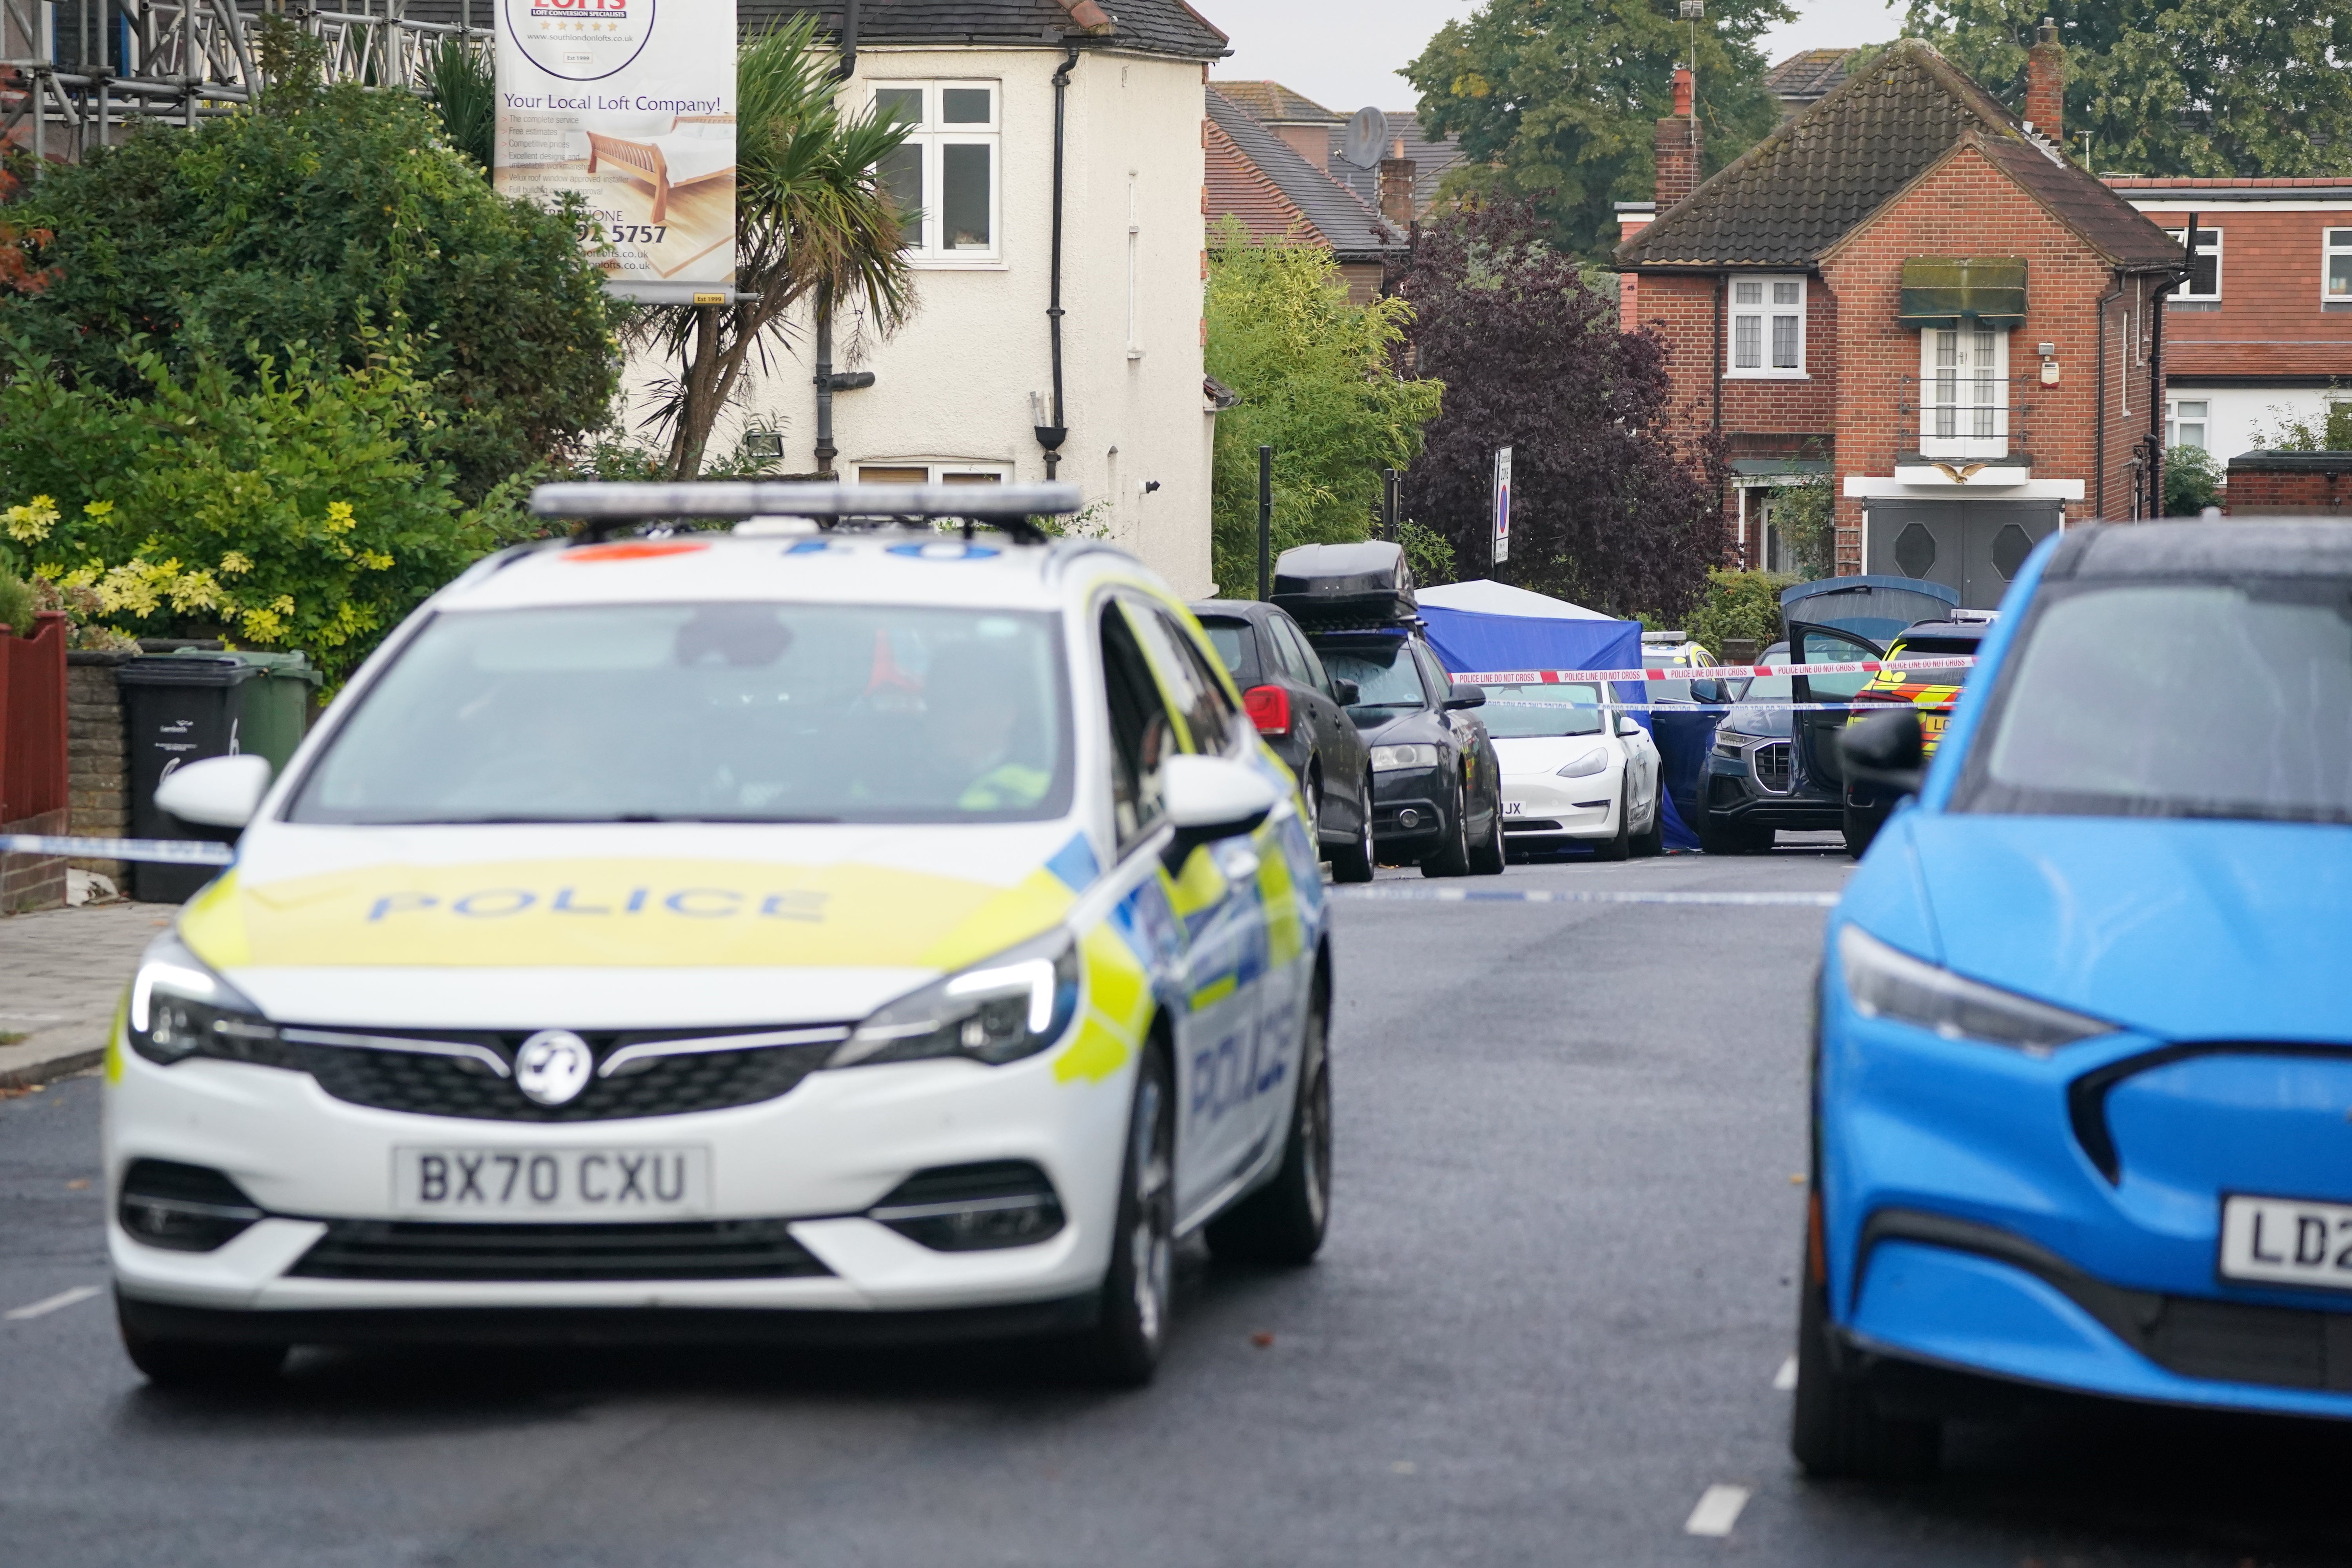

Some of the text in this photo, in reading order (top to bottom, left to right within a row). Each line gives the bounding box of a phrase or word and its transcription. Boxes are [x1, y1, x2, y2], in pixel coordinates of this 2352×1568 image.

[527, 34, 633, 42] www.southlondonlofts.co.uk
[504, 93, 720, 115] Your Local Loft Company!
[509, 114, 521, 123] The
[523, 116, 554, 124] complete
[509, 139, 570, 149] Competitive prices
[539, 152, 565, 162] designs
[570, 176, 600, 184] approved
[612, 225, 666, 243] 5757
[1671, 670, 1690, 678] POLICE
[1692, 669, 1704, 677] LINE
[1728, 668, 1747, 676] CROSS
[1778, 666, 1798, 674] POLICE
[1837, 664, 1855, 672] CROSS
[1460, 675, 1479, 683] POLICE
[1481, 674, 1492, 682] LINE
[1516, 673, 1534, 682] CROSS
[1565, 673, 1584, 681] POLICE
[1586, 672, 1598, 681] LINE
[1609, 671, 1620, 680] NOT
[1622, 671, 1640, 679] CROSS
[367, 887, 829, 924] POLICE
[421, 1154, 685, 1203] BX70 CXU
